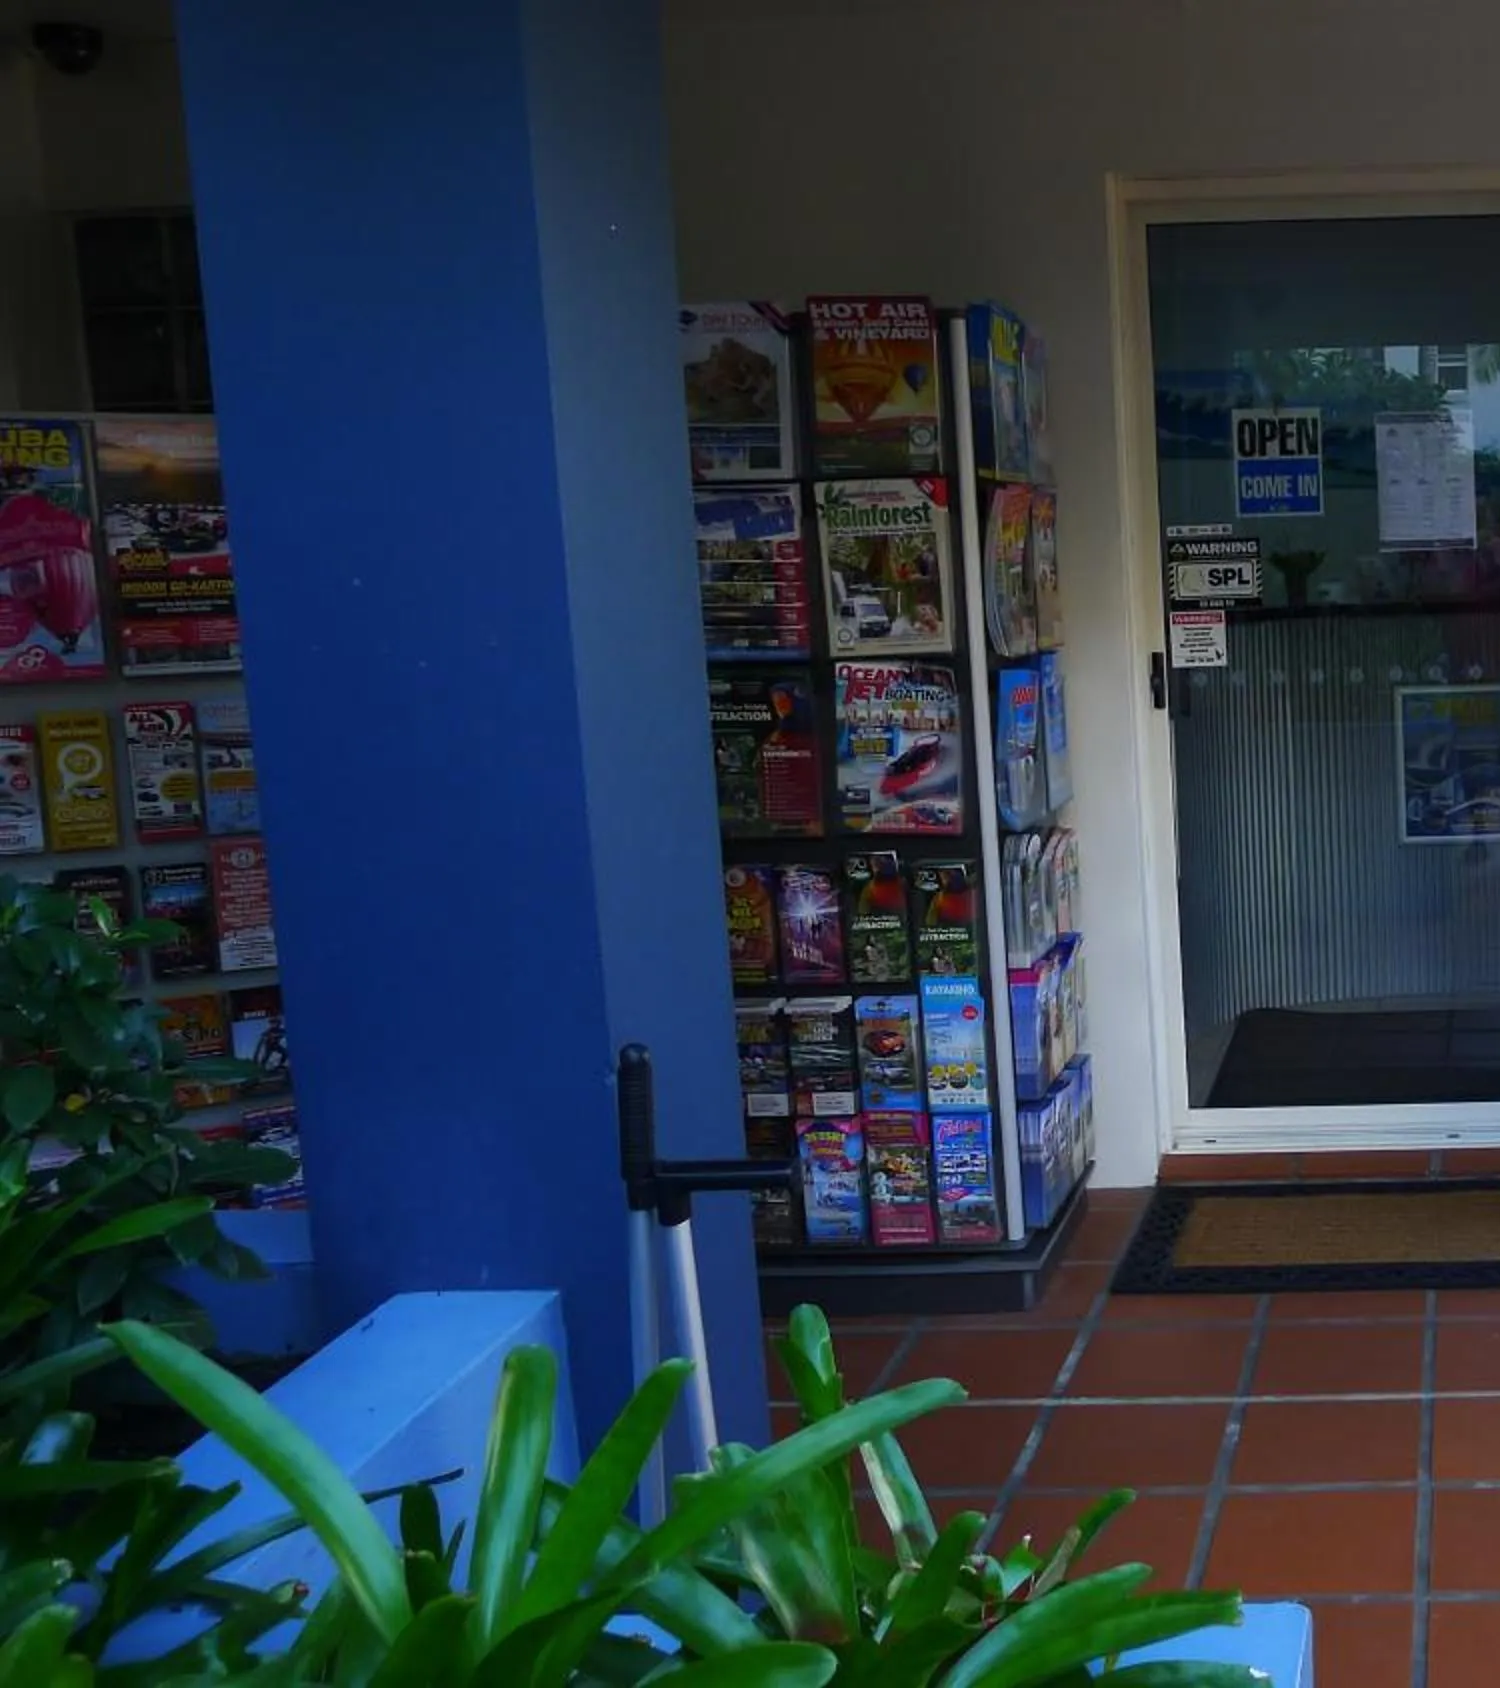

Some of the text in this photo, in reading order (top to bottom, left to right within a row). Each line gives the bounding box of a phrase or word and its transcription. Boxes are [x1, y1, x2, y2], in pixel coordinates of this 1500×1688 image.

[809, 302, 928, 319] HOT AIR
[834, 327, 930, 340] VINEYARD
[1237, 417, 1320, 457] OPEN
[1240, 473, 1319, 500] COME IN
[826, 501, 932, 529] Rainforest
[1186, 540, 1258, 556] WARNING
[1208, 567, 1250, 587] SPL
[839, 664, 901, 682] OCEAN
[845, 681, 886, 705] JET
